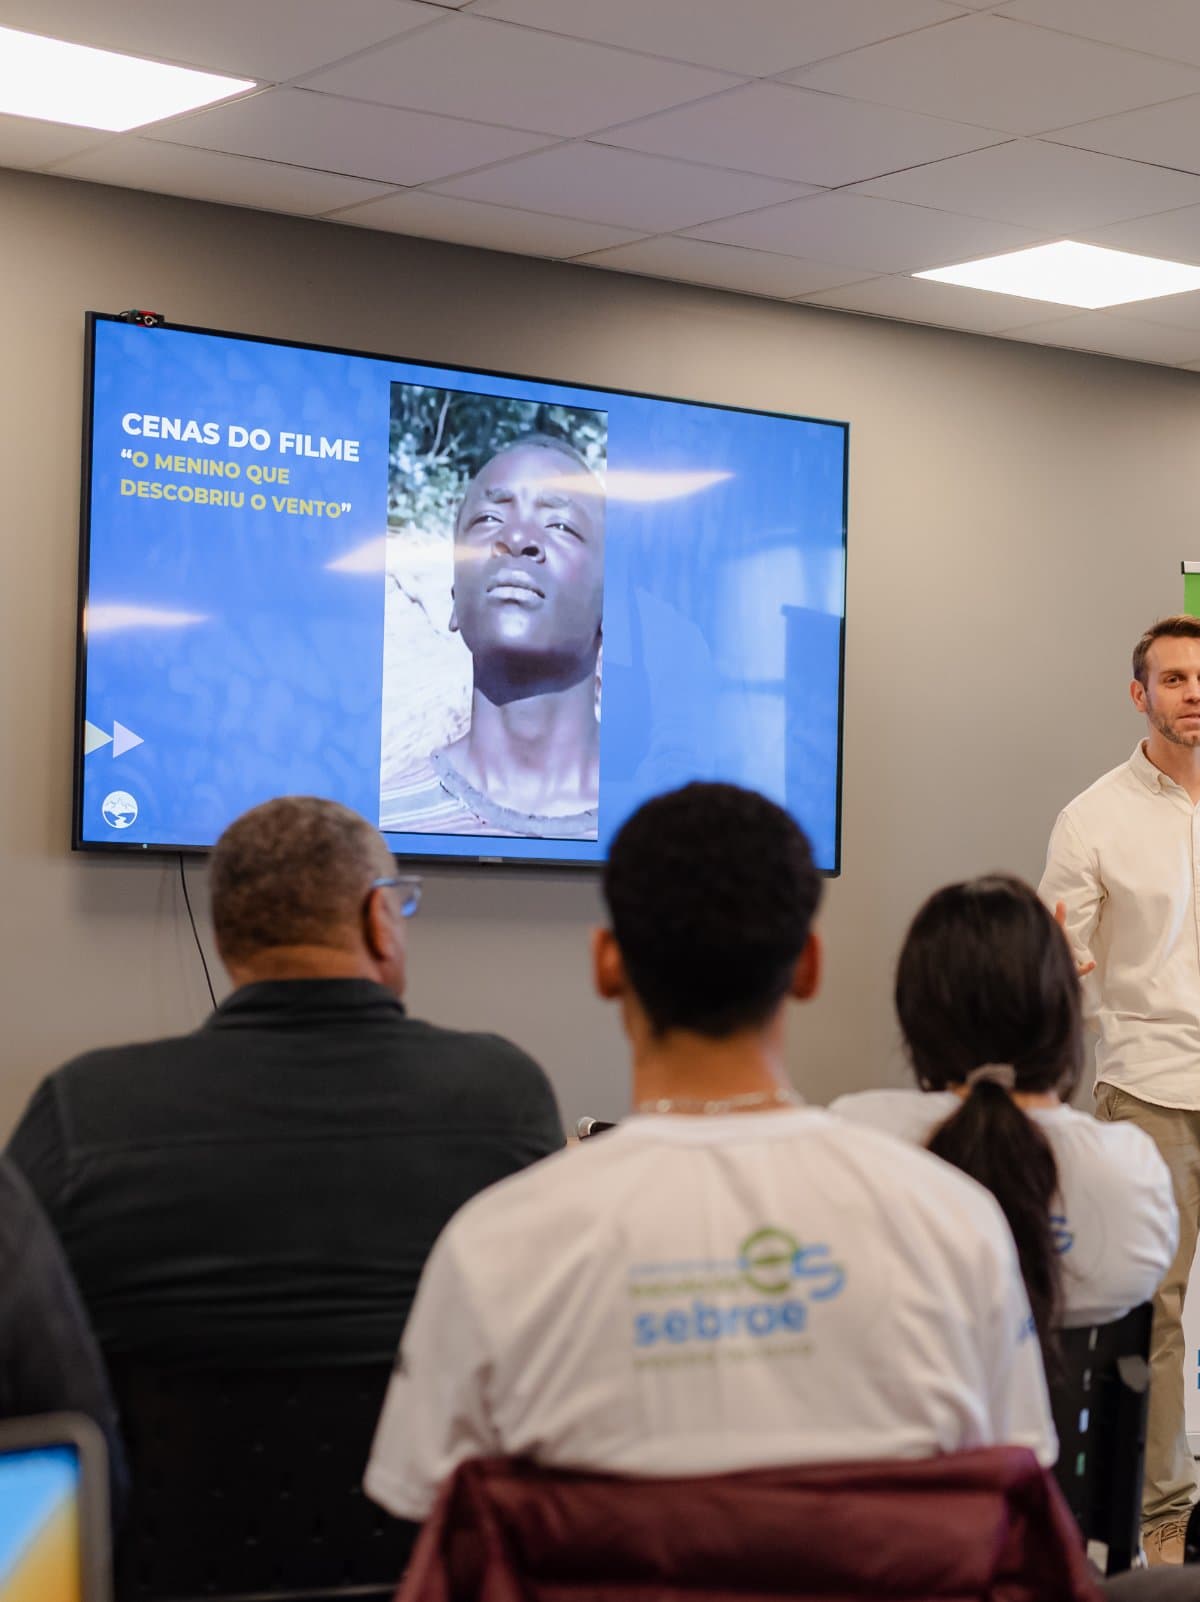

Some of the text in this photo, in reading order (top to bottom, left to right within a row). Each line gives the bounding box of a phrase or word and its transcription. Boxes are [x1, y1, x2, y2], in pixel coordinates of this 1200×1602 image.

[121, 412, 360, 463] CENAS DO FILME
[154, 453, 241, 479] MENINO
[246, 465, 290, 485] QUE
[120, 478, 245, 508] DESCOBRIU
[250, 494, 267, 511] O
